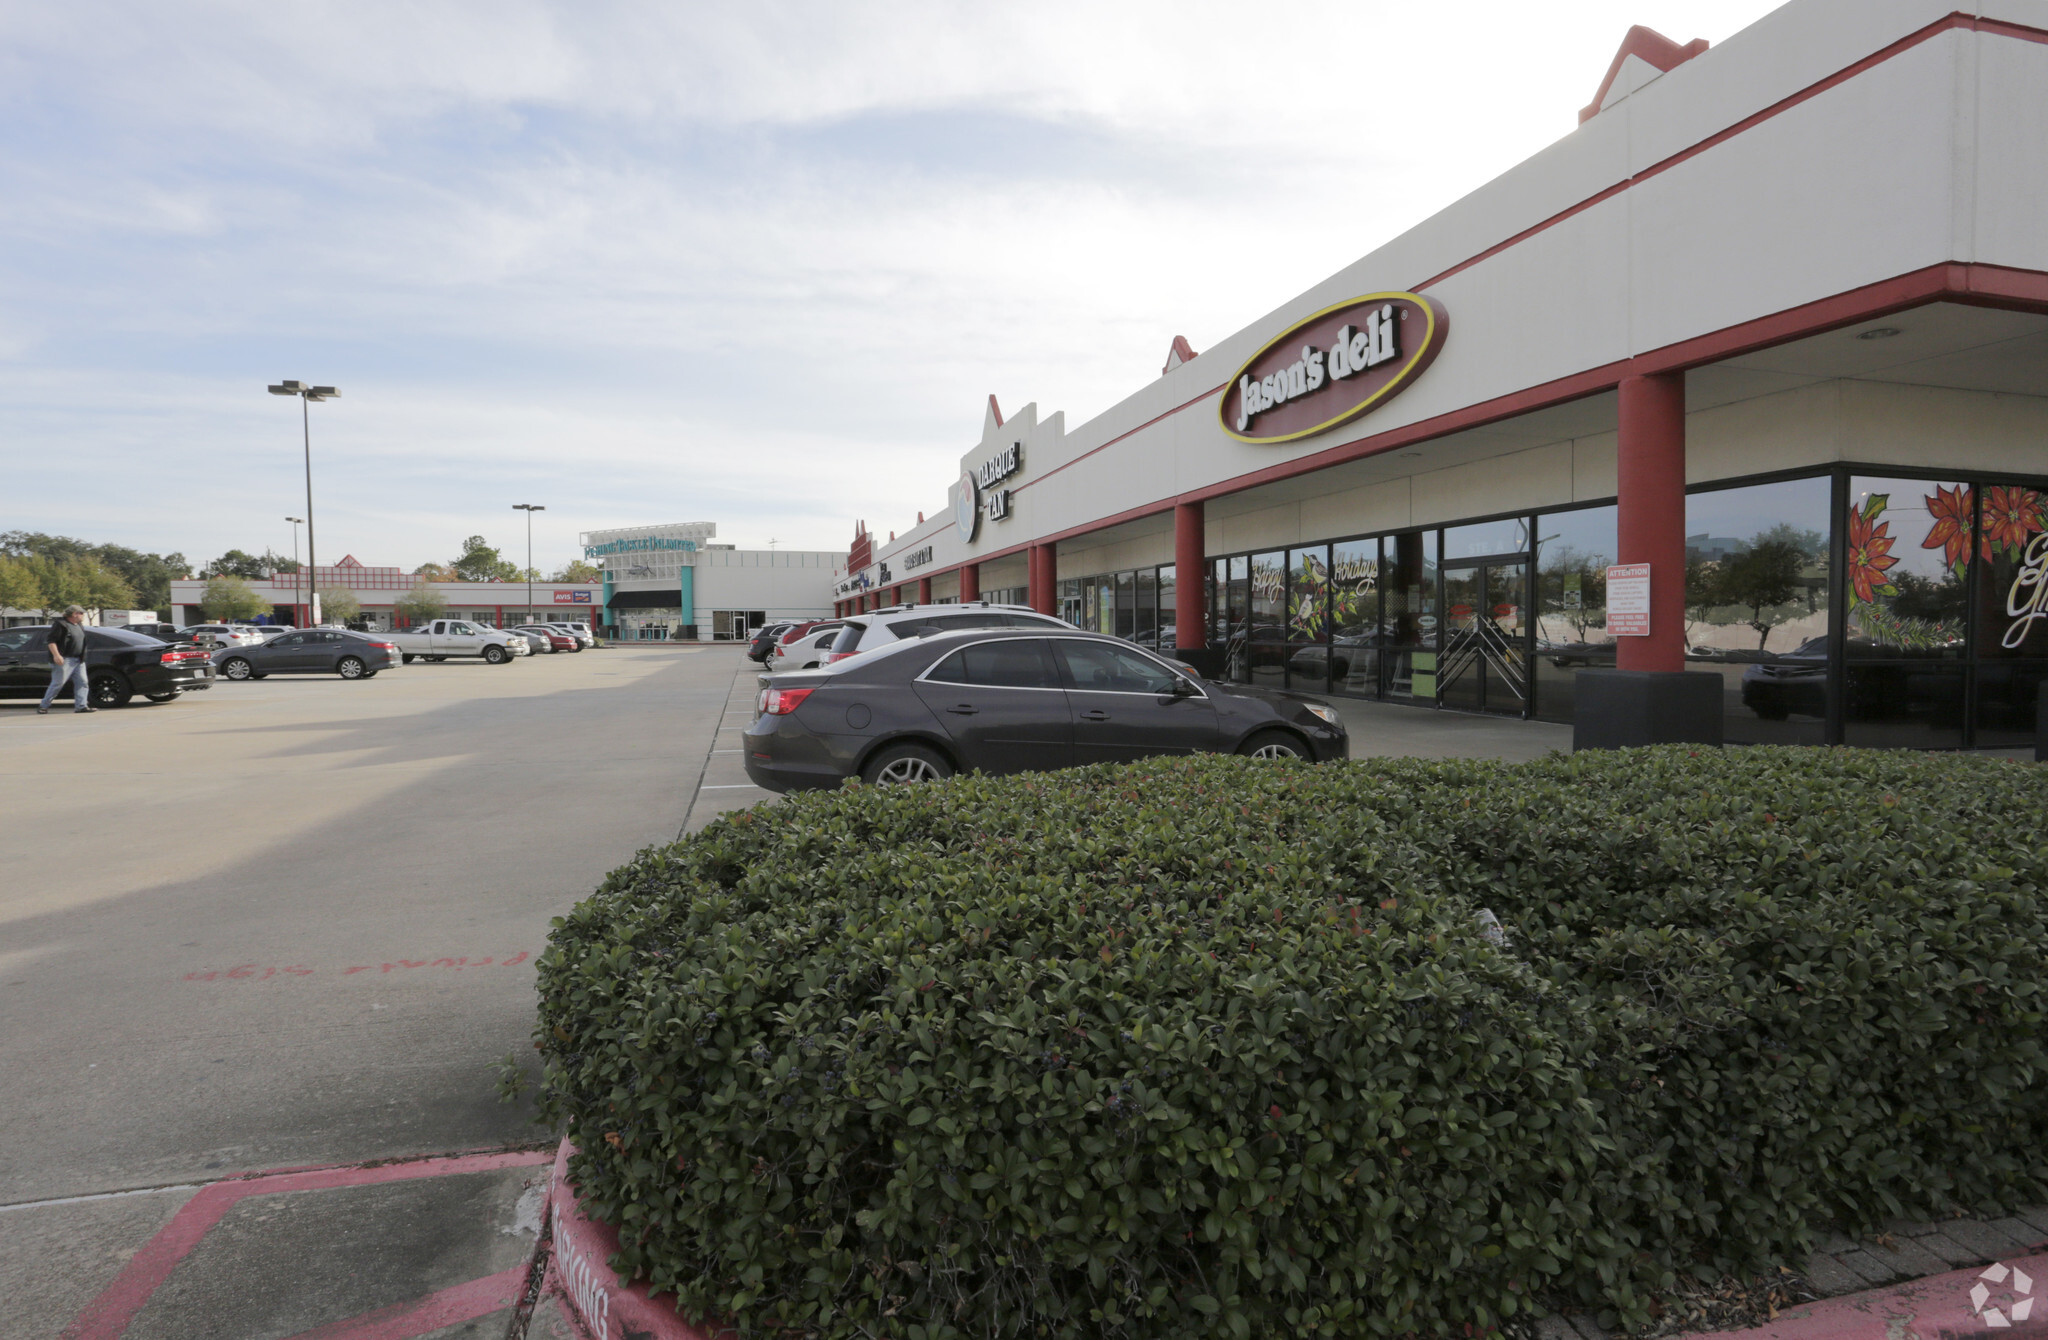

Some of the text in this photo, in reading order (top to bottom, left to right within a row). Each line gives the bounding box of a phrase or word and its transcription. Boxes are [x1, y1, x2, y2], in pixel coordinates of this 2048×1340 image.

[1236, 303, 1396, 432] Jason's deli
[978, 441, 1020, 490] DARQUE
[987, 489, 1009, 521] TAN
[584, 536, 697, 560] FISHING TACKLE UNLIMITED
[1251, 560, 1285, 605] Happy
[1333, 553, 1378, 596] Holidays
[1609, 567, 1648, 577] ATTENTION
